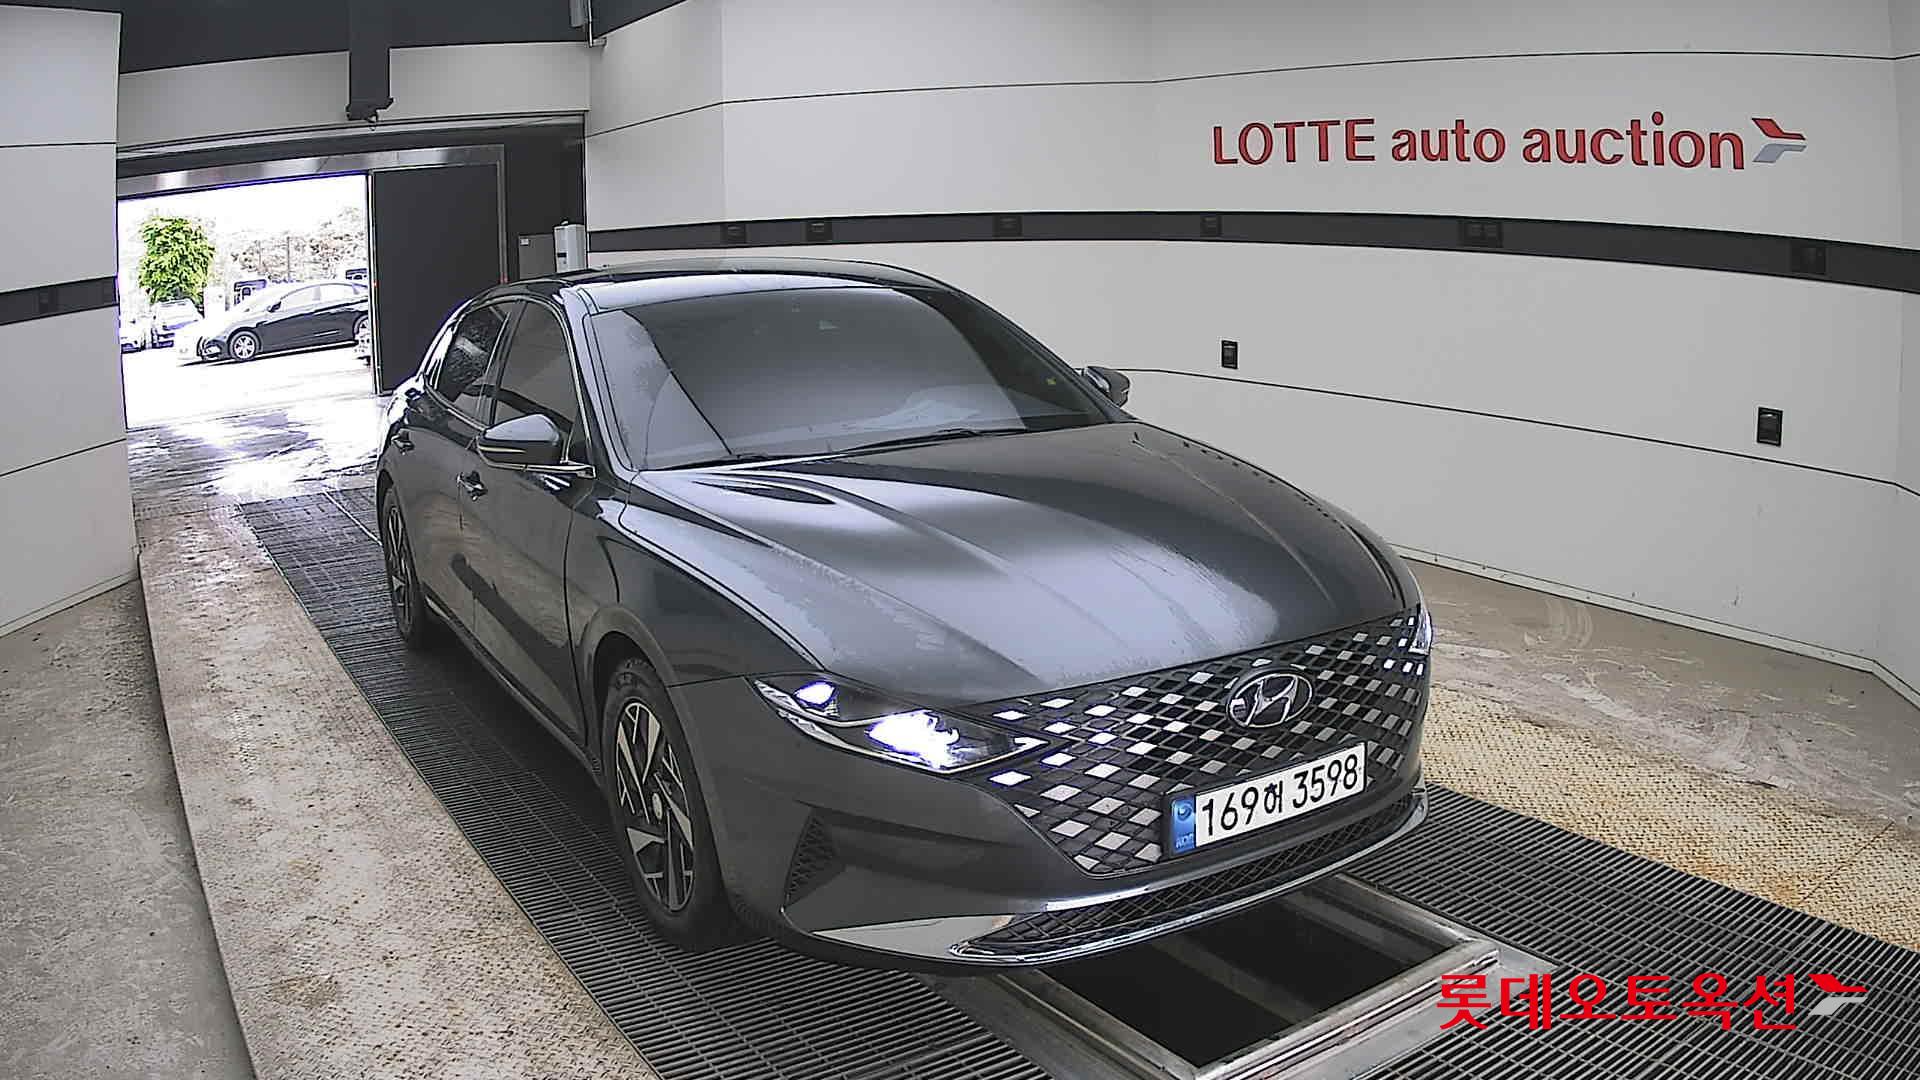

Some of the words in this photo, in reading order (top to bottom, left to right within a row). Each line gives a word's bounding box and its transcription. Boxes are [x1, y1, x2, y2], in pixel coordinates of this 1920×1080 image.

[1213, 118, 1375, 165] LOTTE
[1391, 119, 1506, 162] auto
[1522, 111, 1744, 170] auction
[1203, 781, 1284, 836] 169허
[1293, 754, 1359, 808] 3598
